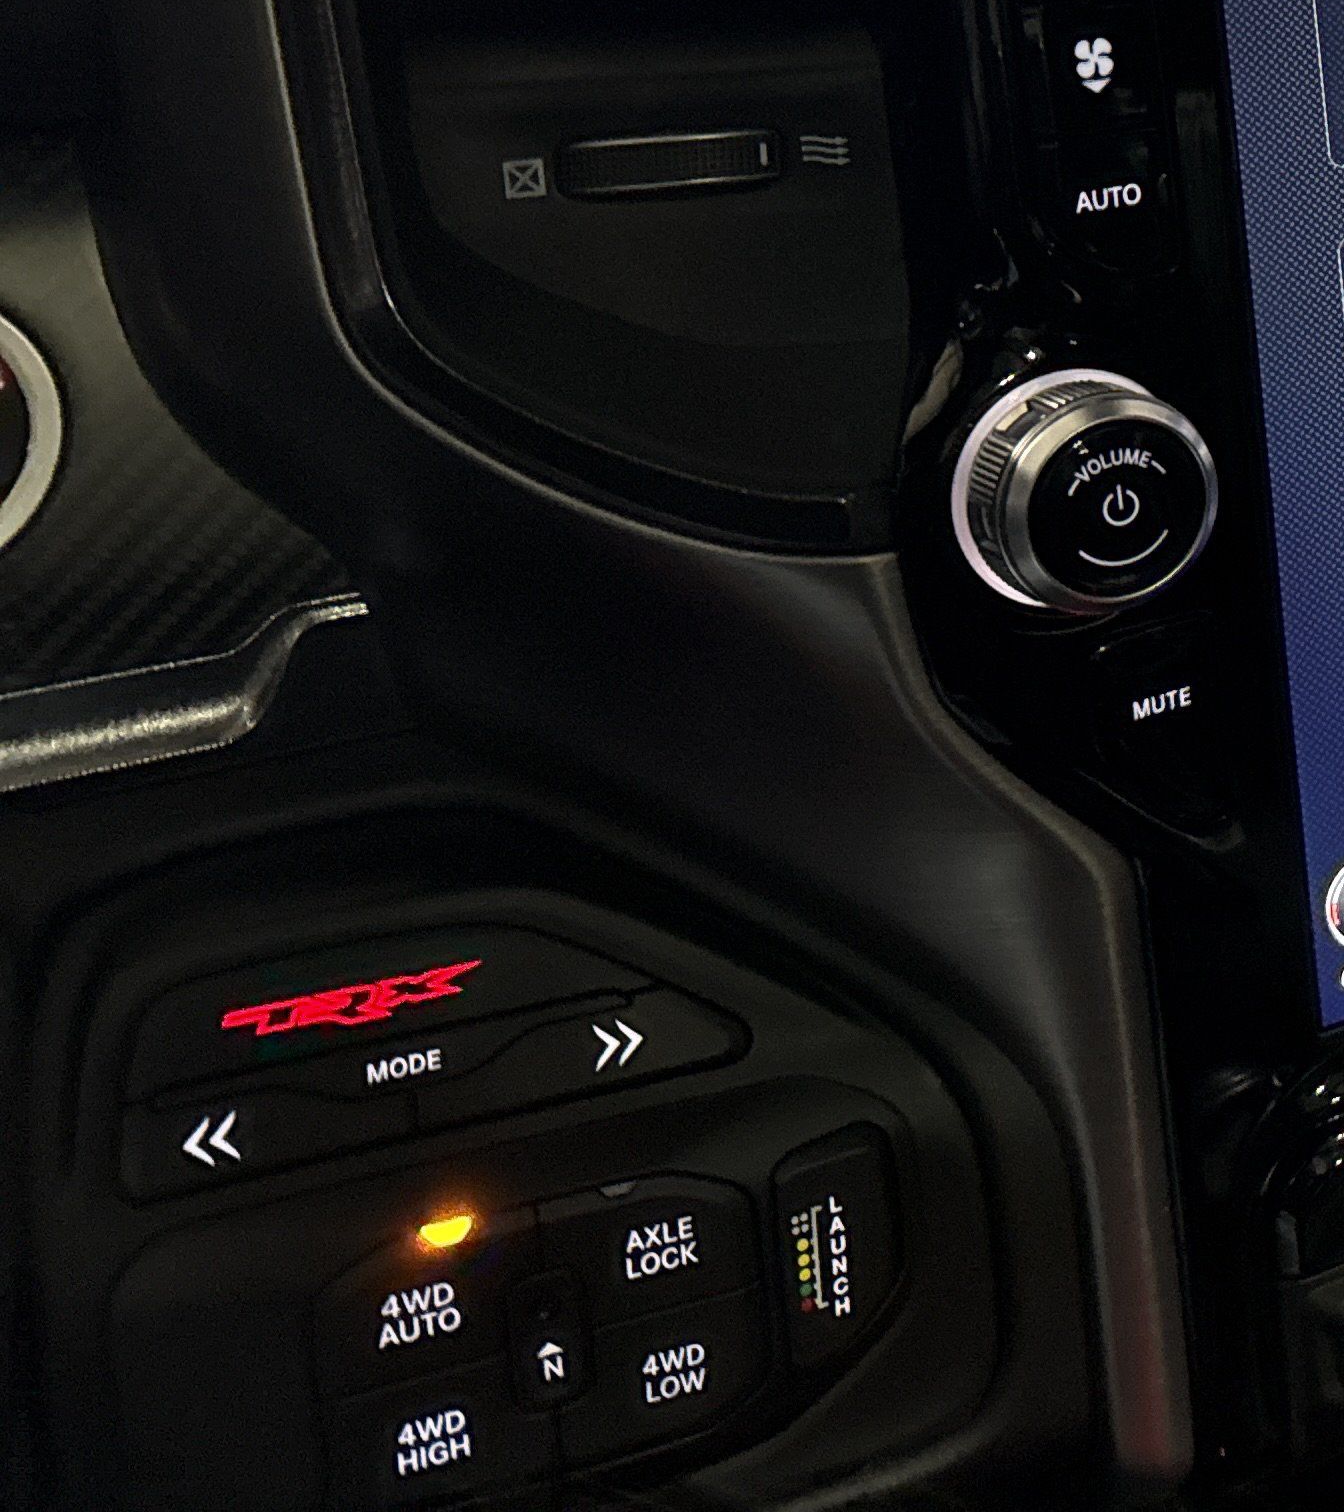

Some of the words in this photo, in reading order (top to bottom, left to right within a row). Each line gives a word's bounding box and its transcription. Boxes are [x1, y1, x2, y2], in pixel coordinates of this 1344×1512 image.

[1076, 183, 1142, 214] AUTO
[1074, 447, 1152, 482] VOLUME
[1132, 686, 1192, 720] MUTE
[366, 1048, 441, 1084] MODE
[626, 1215, 694, 1254] AXLE
[625, 1241, 699, 1280] LOCK
[828, 1196, 851, 1317] LAUNCH
[381, 1282, 455, 1318] 4WD
[379, 1306, 461, 1349] AUTO
[543, 1355, 564, 1381] N
[642, 1343, 705, 1376] 4WD
[645, 1367, 706, 1403] LOW
[397, 1410, 466, 1446] 4WD
[397, 1433, 471, 1475] HIGH
